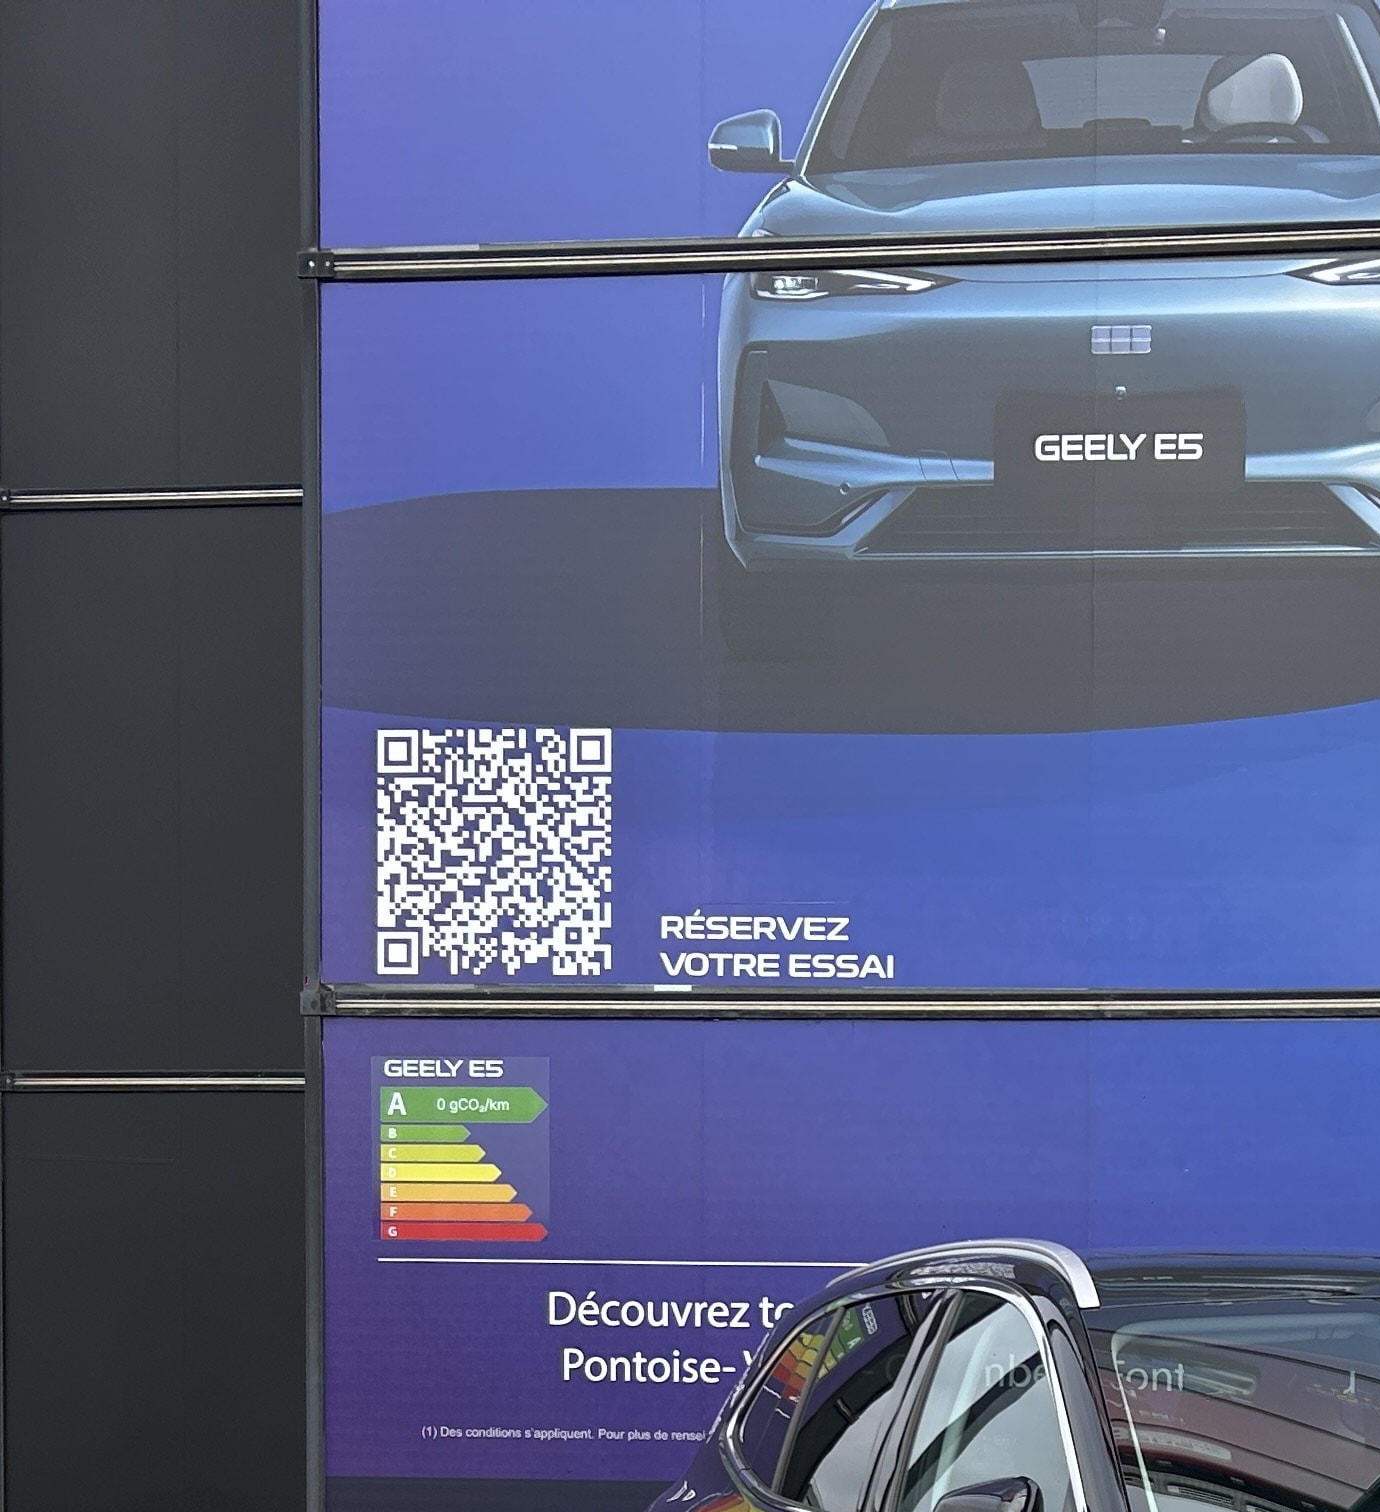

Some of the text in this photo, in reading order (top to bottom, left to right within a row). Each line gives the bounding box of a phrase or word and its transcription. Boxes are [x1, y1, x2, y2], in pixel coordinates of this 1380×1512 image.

[1034, 433, 1204, 461] GEELY E5
[660, 909, 850, 941] RÉSERVEZ
[659, 952, 894, 979] VOTRE ESSAI
[383, 1059, 504, 1078] GEELY E5
[387, 1091, 407, 1116] A
[548, 1290, 749, 1328] Découvrez
[563, 1347, 737, 1384] Pontoise-
[420, 1425, 438, 1441] (1)
[440, 1426, 463, 1438] Des
[465, 1426, 522, 1439] conditions
[598, 1428, 625, 1440] Pour
[627, 1429, 651, 1442] plus
[653, 1429, 669, 1441] de
